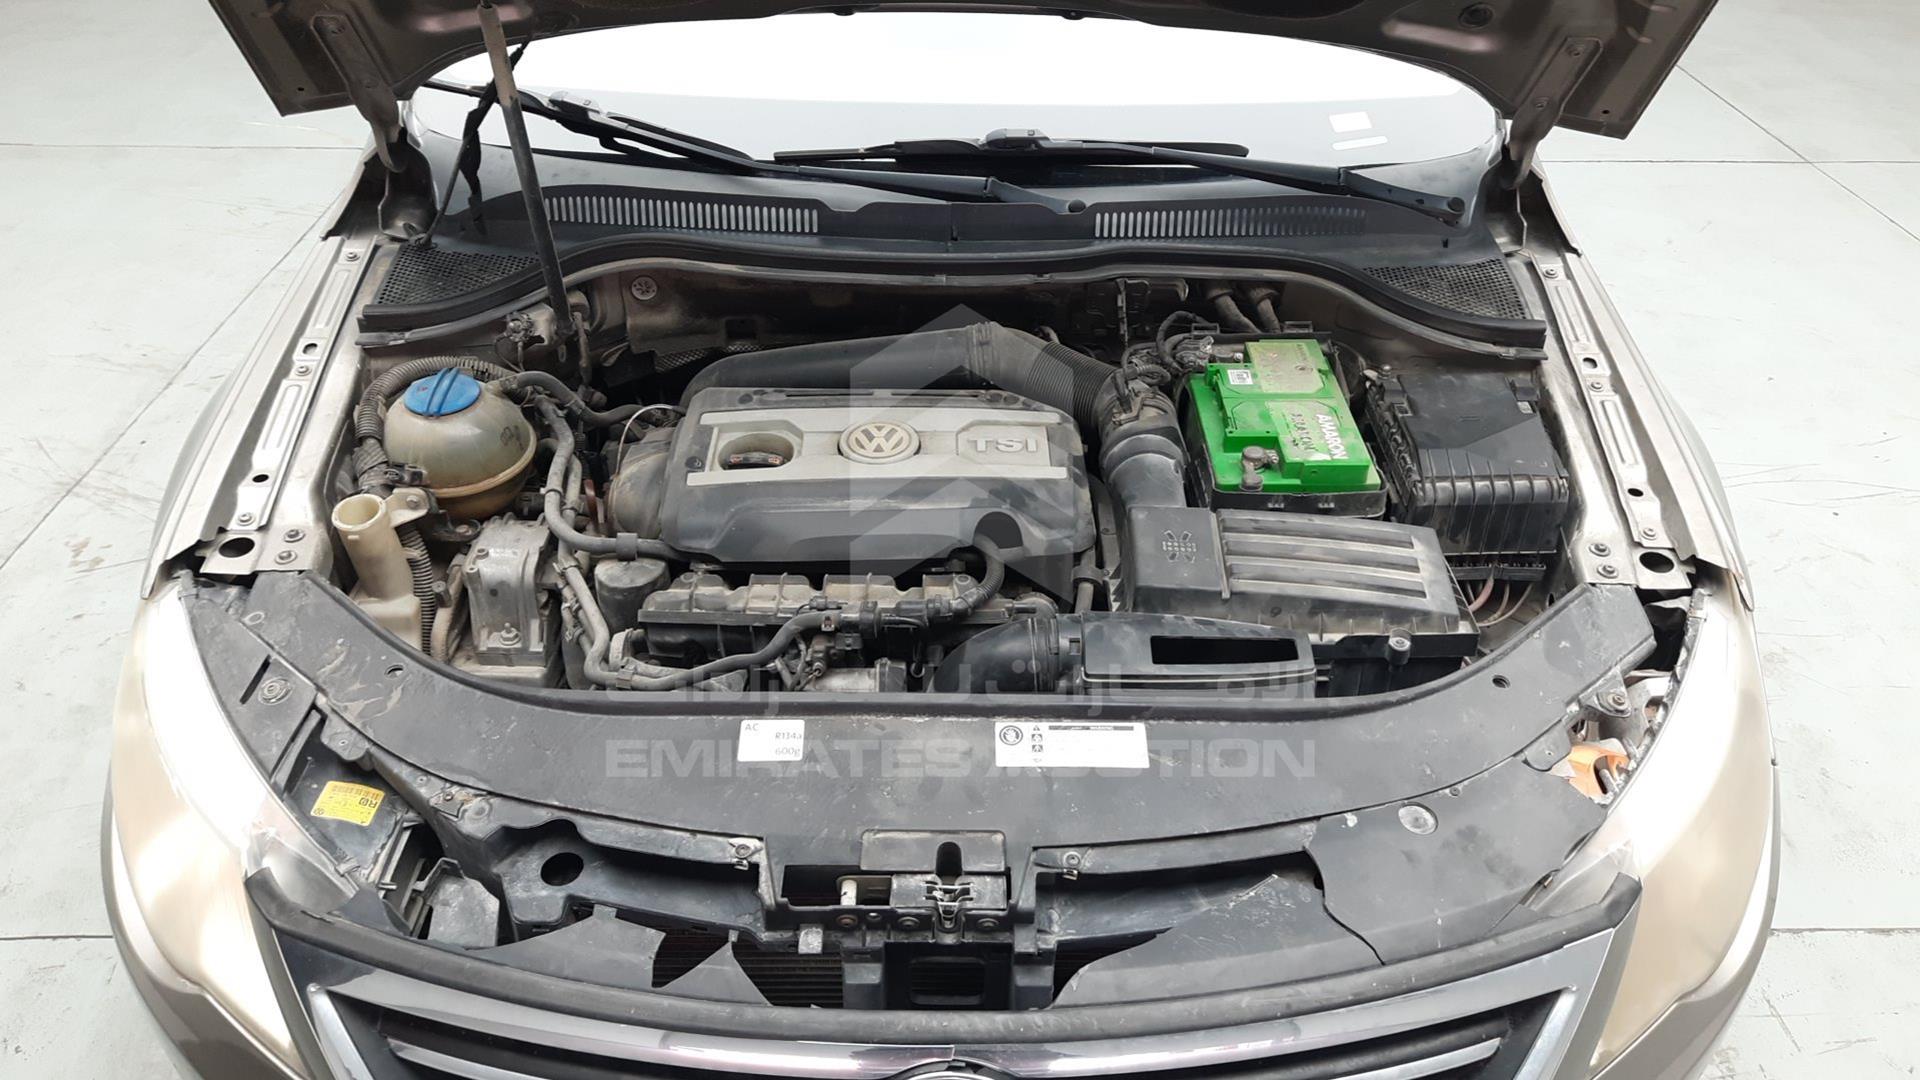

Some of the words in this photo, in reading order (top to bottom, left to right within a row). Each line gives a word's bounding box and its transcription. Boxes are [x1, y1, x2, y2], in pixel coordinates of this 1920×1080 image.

[1315, 413, 1349, 459] AMARON
[967, 437, 1039, 453] TSI
[745, 723, 759, 731] AC
